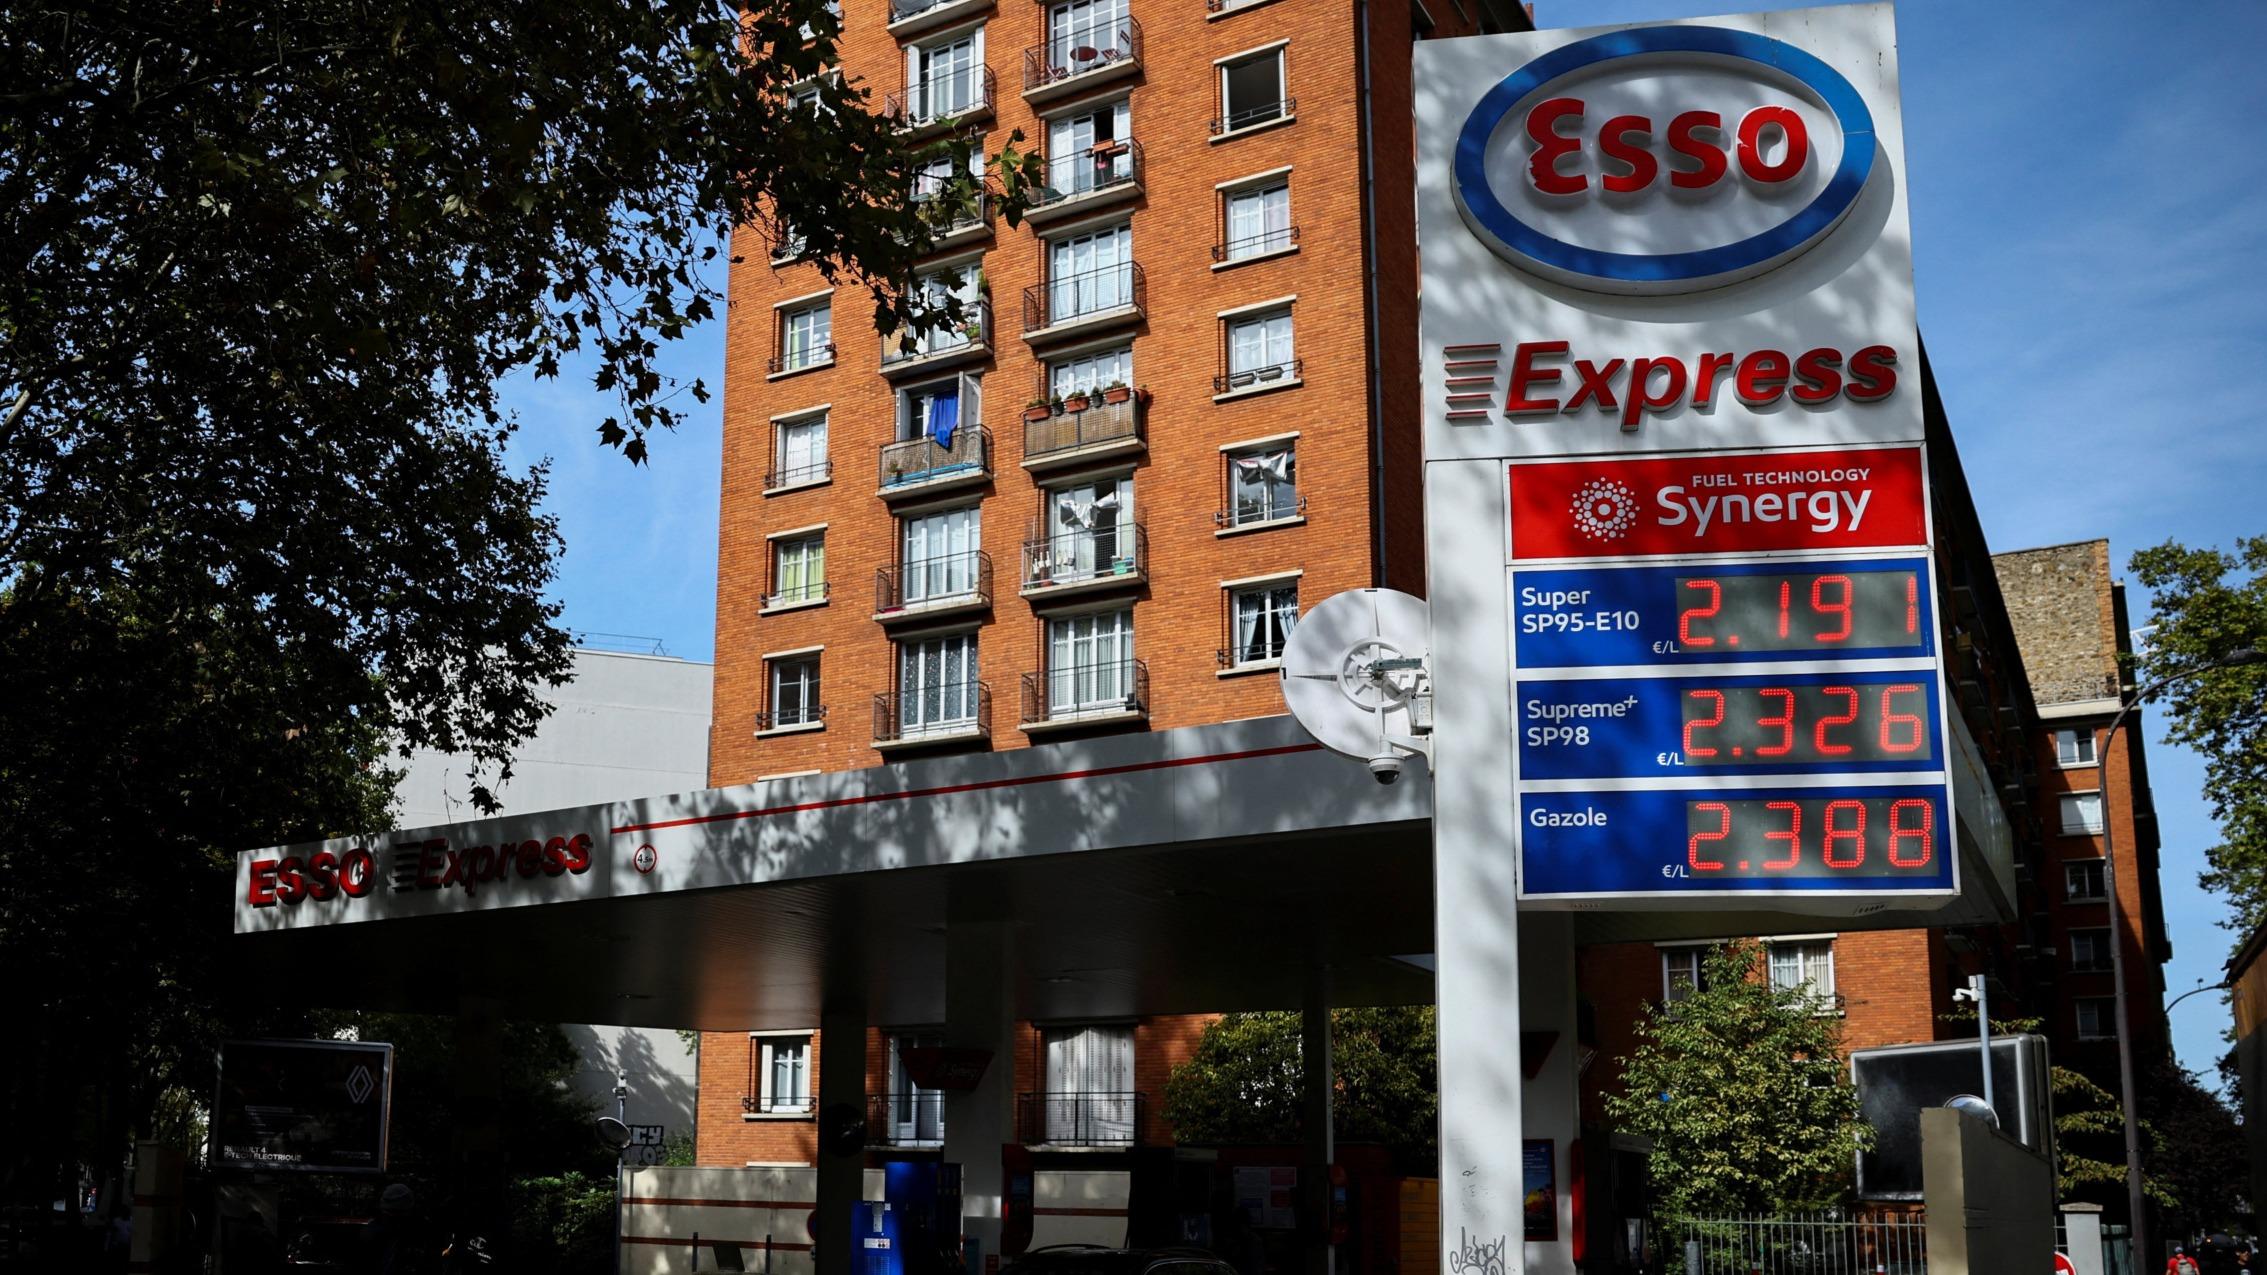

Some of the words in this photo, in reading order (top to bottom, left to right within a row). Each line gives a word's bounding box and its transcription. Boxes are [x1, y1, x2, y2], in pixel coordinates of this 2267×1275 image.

[1505, 341, 1897, 431] Express
[1692, 474, 1738, 488] FUEL
[1743, 468, 1870, 486] TECHNOLOGY
[1656, 485, 1872, 537] Synergy
[1521, 587, 1591, 611] Super
[1679, 575, 1917, 646] 2.191
[1522, 611, 1640, 634] SP95-E10
[1652, 640, 1679, 655] €/L
[1683, 685, 1923, 757] 2.326
[1527, 726, 1590, 747] SP98
[1656, 752, 1684, 767] €/L
[1530, 807, 1607, 827] Gazole
[1688, 799, 1932, 870] 2.388
[248, 848, 376, 906] ESSO
[416, 834, 592, 896] Express
[1662, 864, 1689, 879] €/L
